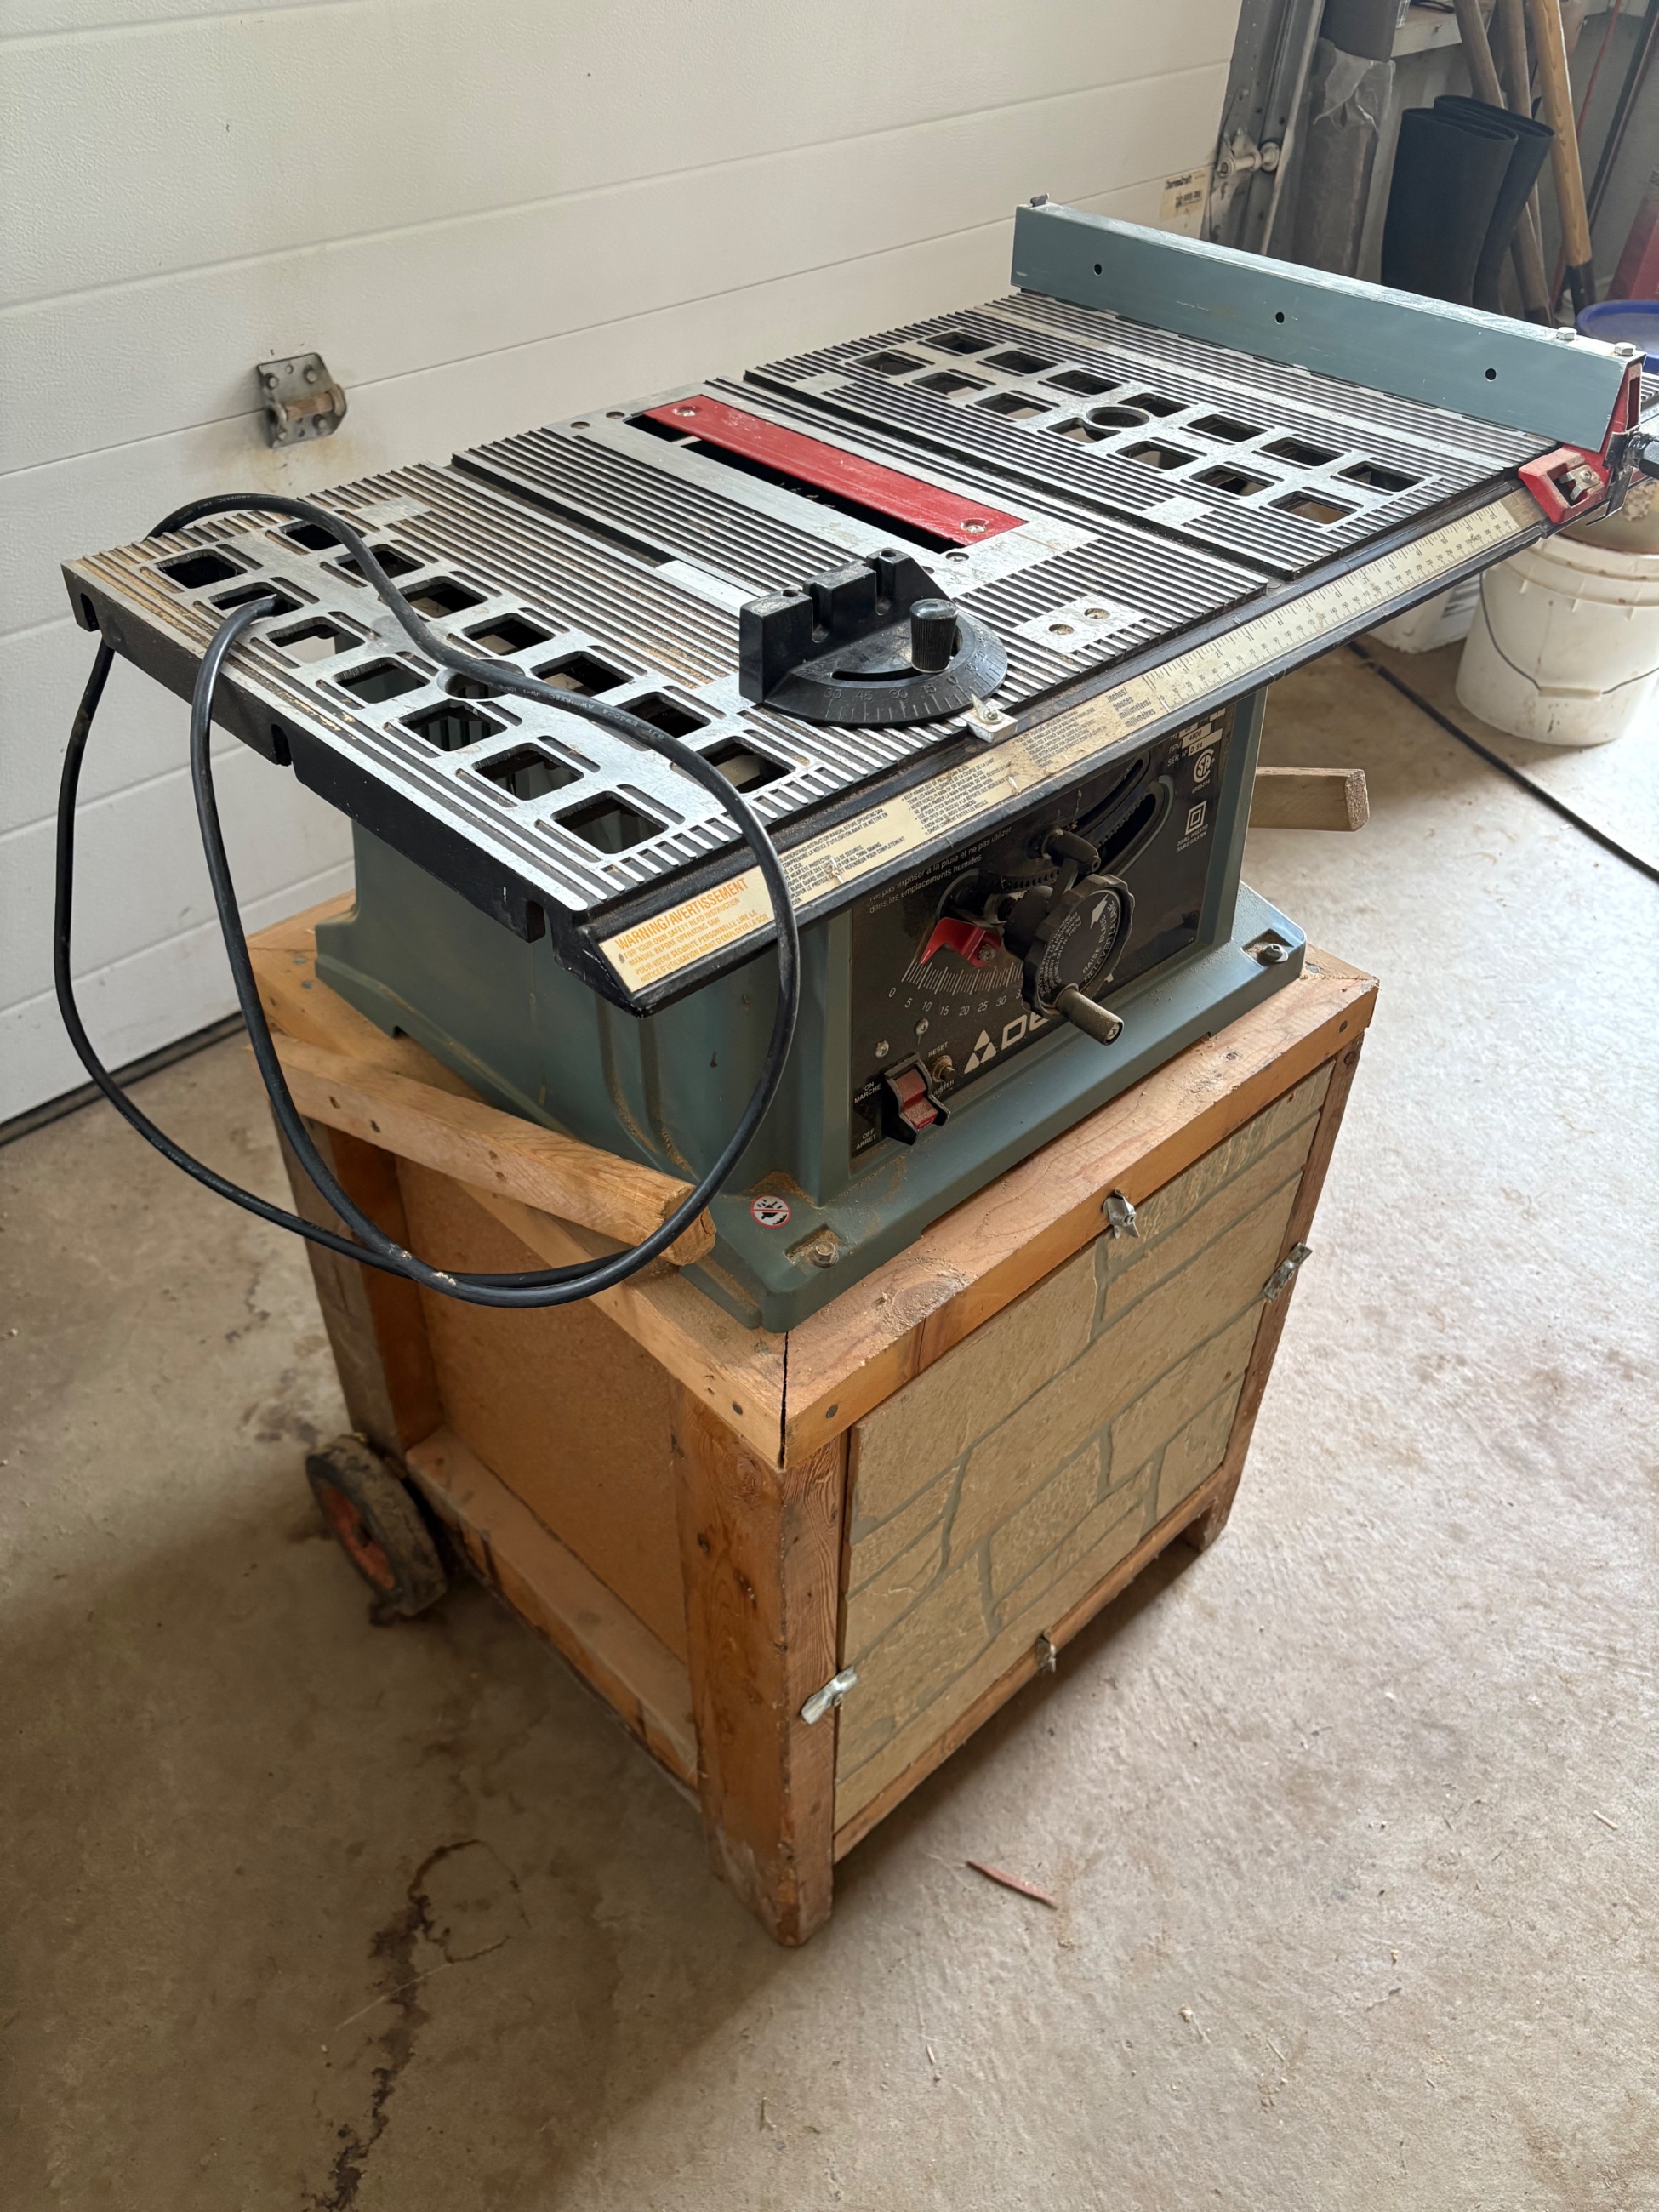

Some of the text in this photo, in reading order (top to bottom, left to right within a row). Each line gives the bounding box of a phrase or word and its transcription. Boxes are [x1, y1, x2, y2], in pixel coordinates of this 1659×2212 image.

[856, 690, 873, 701] 45
[948, 676, 959, 685] 0
[1113, 697, 1133, 712] pouces
[1168, 754, 1179, 766] SER
[1169, 742, 1181, 754] RPM
[897, 869, 925, 888] exposer
[933, 861, 940, 871] la
[941, 855, 959, 869] pluie
[960, 851, 967, 859] et
[969, 846, 977, 855] ne
[978, 840, 990, 852] pas
[991, 826, 1012, 841] utilizer
[869, 900, 887, 914] dans
[888, 892, 899, 904] les
[901, 869, 952, 898] emplacements
[613, 875, 749, 951] WARNING/AVERTISSEMENT
[623, 896, 740, 959] FOR YOUR OWN SAFETY READ INSTRUCTION
[628, 915, 720, 966] MANUAL BEFORE OPERATING SAW
[634, 961, 653, 976] POUR
[652, 952, 671, 967] VOTRE
[698, 919, 737, 944] PERSONNELLE
[736, 912, 749, 925] LIRE
[748, 908, 757, 918] LA
[640, 968, 661, 983] NOTICE
[698, 939, 715, 953] AVANT
[749, 918, 756, 927] LA
[755, 912, 768, 924] SCIE
[1082, 947, 1101, 973] RAISE
[888, 988, 896, 997] 0
[904, 997, 912, 1008] 5
[922, 1001, 932, 1012] 10
[940, 1006, 949, 1016] 15
[959, 1006, 970, 1016] 20
[978, 1001, 989, 1012] 25
[996, 995, 1006, 1006] 30
[928, 1041, 949, 1058] RESET
[854, 1083, 881, 1104] MARCHE
[864, 1081, 875, 1091] ON
[856, 1133, 876, 1150] ARRET
[862, 1128, 875, 1139] OFF
